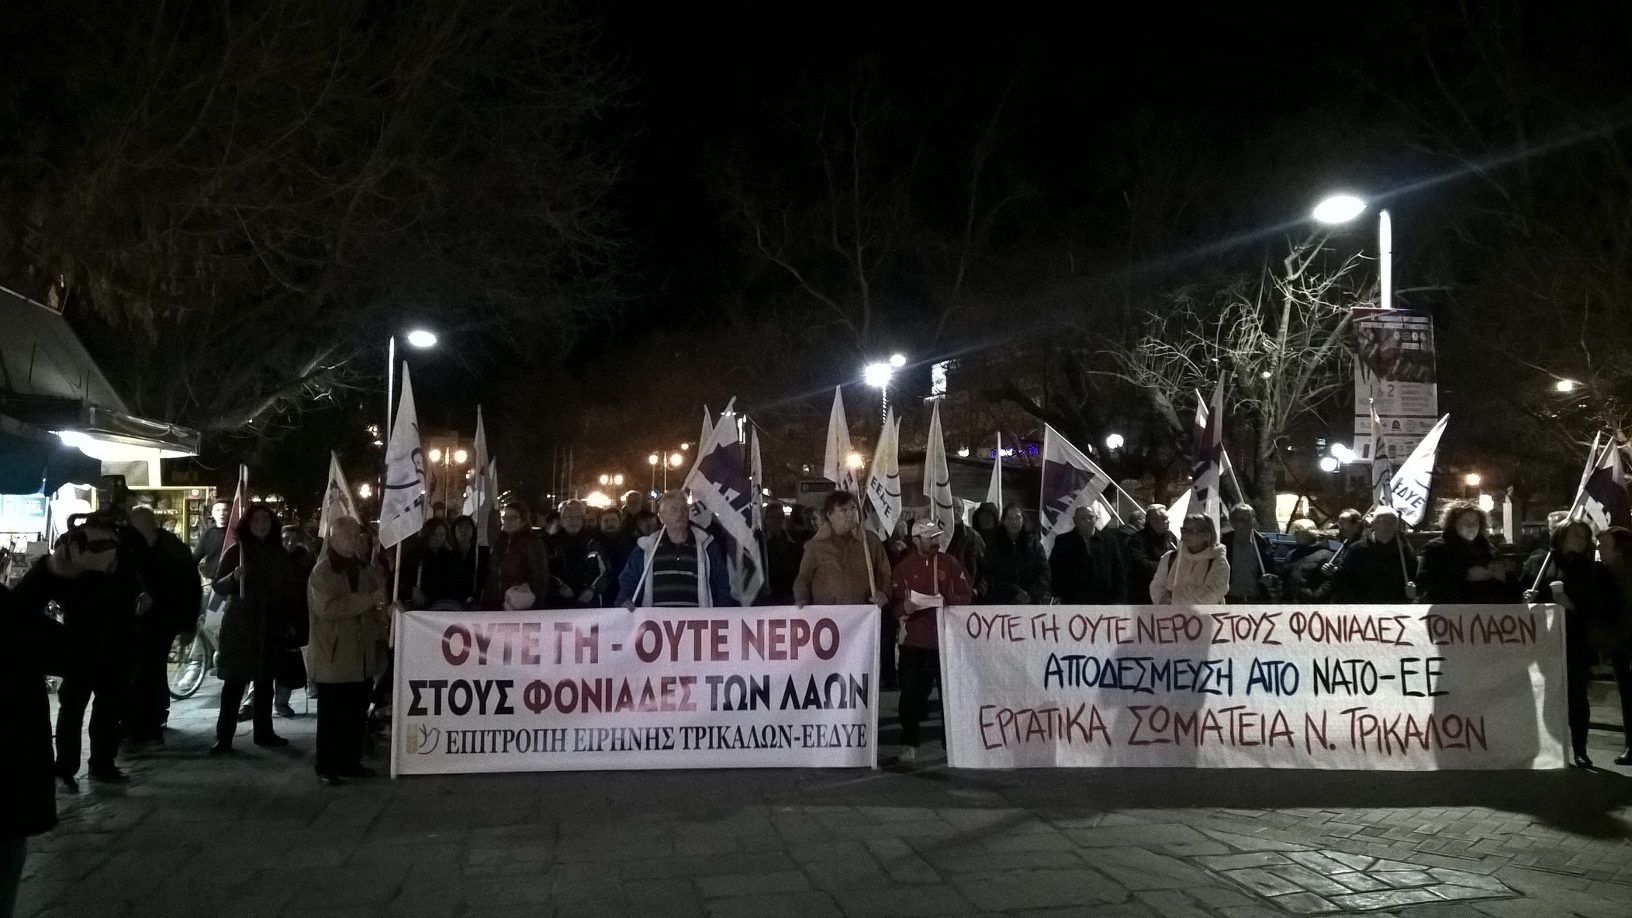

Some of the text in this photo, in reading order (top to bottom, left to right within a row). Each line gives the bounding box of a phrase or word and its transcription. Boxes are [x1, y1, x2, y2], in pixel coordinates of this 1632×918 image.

[1387, 384, 1395, 398] 2
[441, 622, 541, 666] ΟΥΤΕ
[553, 622, 599, 665] ΓΗ
[635, 619, 729, 663] ΟΥΤΕ
[741, 617, 840, 661] ΝΕΡΟ
[966, 611, 1537, 647] ΟΥΤΕ ΓΗ ΟΥΤΕ ΝΕΡΟ ΣΤΟΥΣ ΦΟΝΙΑΔΕΣ ΤΩΝ ΛΑΩΝ
[407, 672, 869, 717] ΣΤΟΥΣ ΦΟΝΙΑΔΕΣ ΤΩΝ ΛΑΩΝ
[1044, 652, 1233, 697] ΑΠΟΔΕΣΜΕΥΣΗ
[1246, 656, 1300, 697] ΑΠΟ
[445, 728, 568, 755] ΕΠΙΤΡΟΠΗ
[573, 726, 675, 752] ΕΙΡΗΝΗΣ
[979, 702, 1488, 756] ΕΡΓΑΤΙΚΑ ΣΩΜΑΤΕΙΑ Ν. ΤΡΙΚΑΛΩΝ
